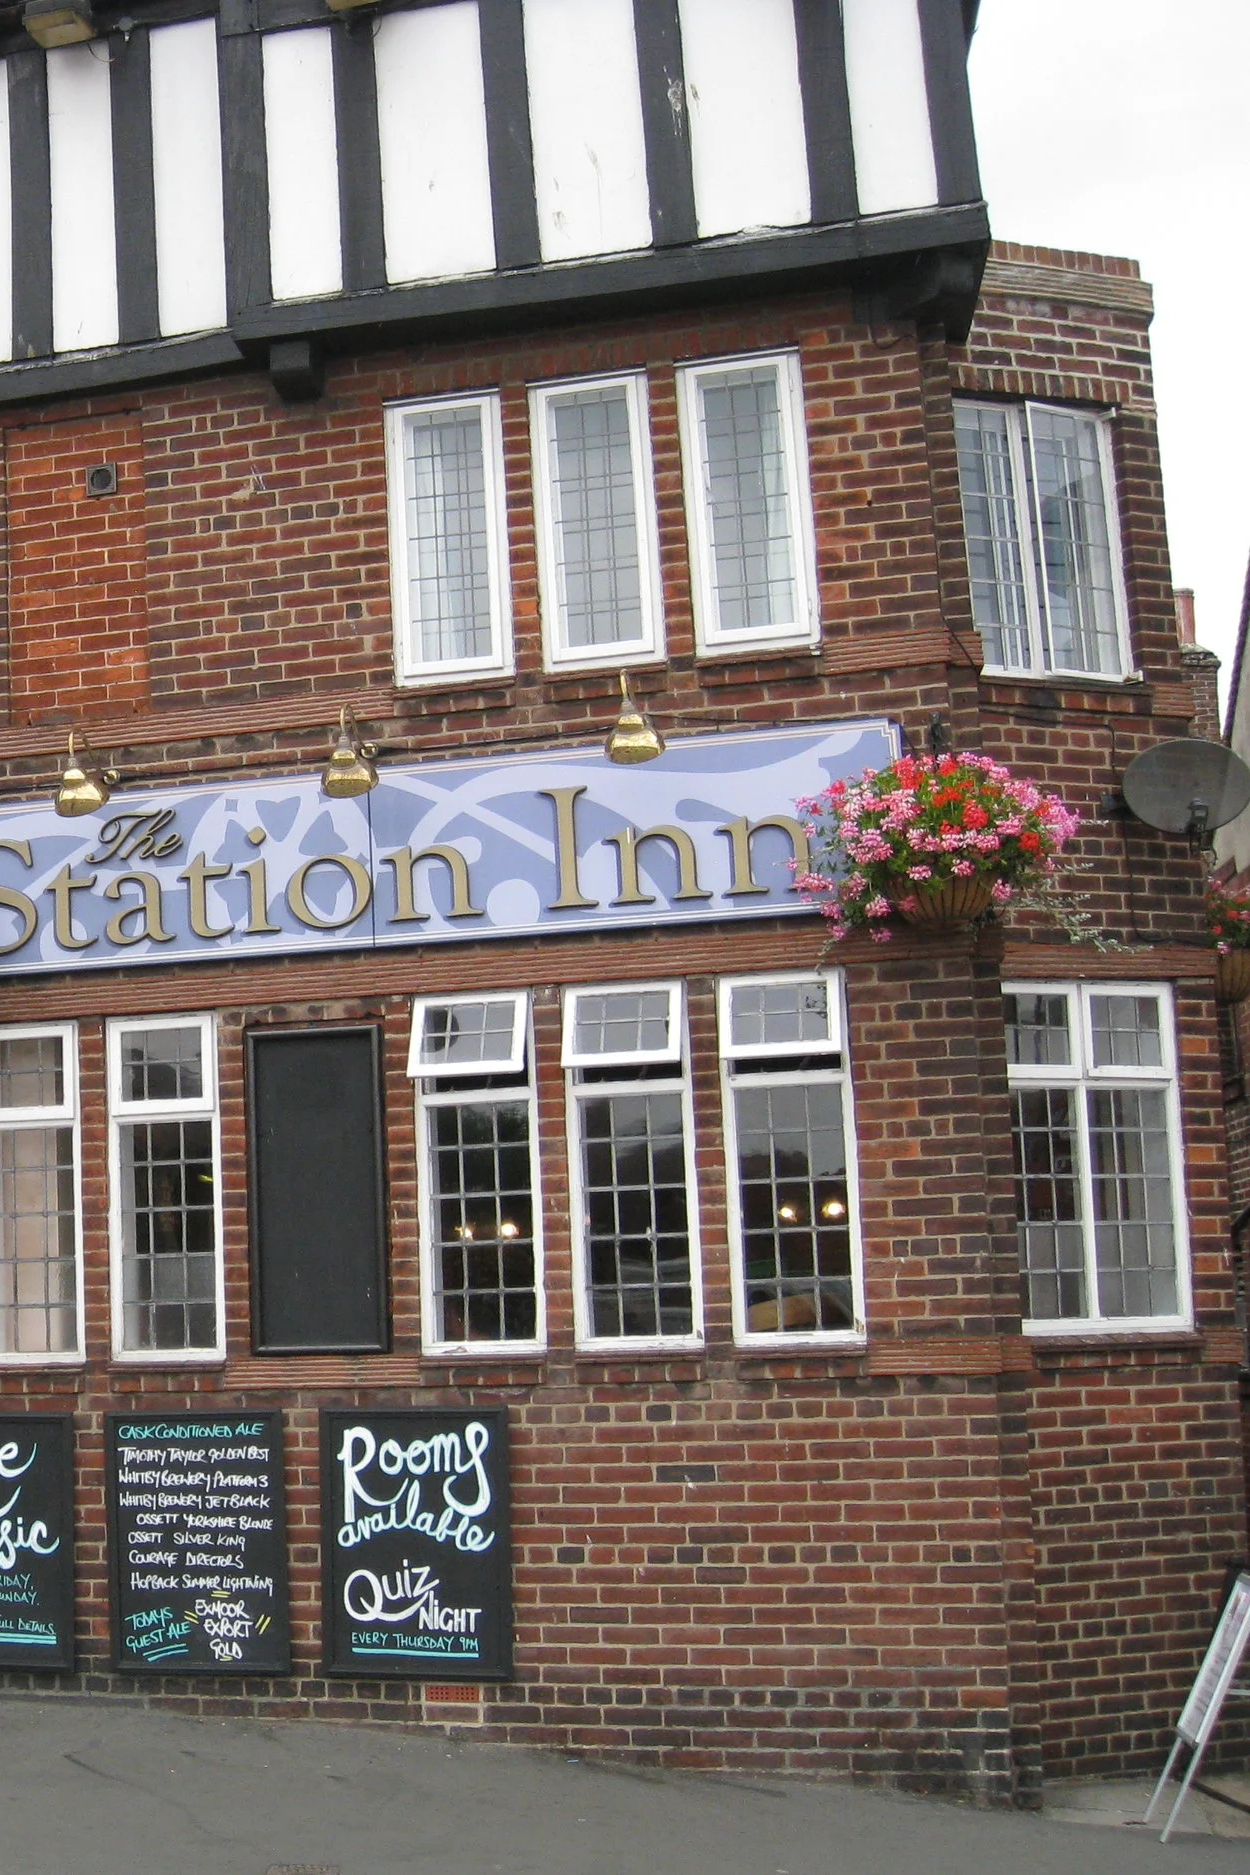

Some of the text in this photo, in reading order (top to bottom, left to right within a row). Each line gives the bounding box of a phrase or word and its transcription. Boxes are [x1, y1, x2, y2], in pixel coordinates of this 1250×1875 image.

[85, 808, 183, 865] The
[537, 785, 816, 912] Inn
[118, 1422, 264, 1440] CASK CONDITIONED ALE
[117, 1445, 270, 1466] TIMOTHY TAYLOR GOLDEN BEST
[118, 1467, 161, 1488] WHITBY
[161, 1469, 210, 1492] BREWERY
[337, 1421, 491, 1523] Rooms
[119, 1491, 270, 1510] WHITBY BREWERY JET BLACK
[136, 1513, 274, 1530] OSSETT YORKSHIRE BLONDE
[337, 1479, 495, 1552] available
[127, 1531, 246, 1552] OSSETT SILVER KING
[128, 1549, 244, 1569] COURAGE DIRECTORS
[130, 1571, 179, 1590] HOPBACK
[182, 1573, 222, 1591] SUMMER
[343, 1558, 440, 1622] Quiz
[124, 1606, 173, 1631] TODAYS
[195, 1599, 249, 1619] EXMOOR
[125, 1621, 192, 1653] GUEST ALE
[203, 1618, 255, 1639] EXPORT
[209, 1638, 243, 1659] GOLD
[351, 1631, 479, 1652] EVERY THURSDAY 9PM
